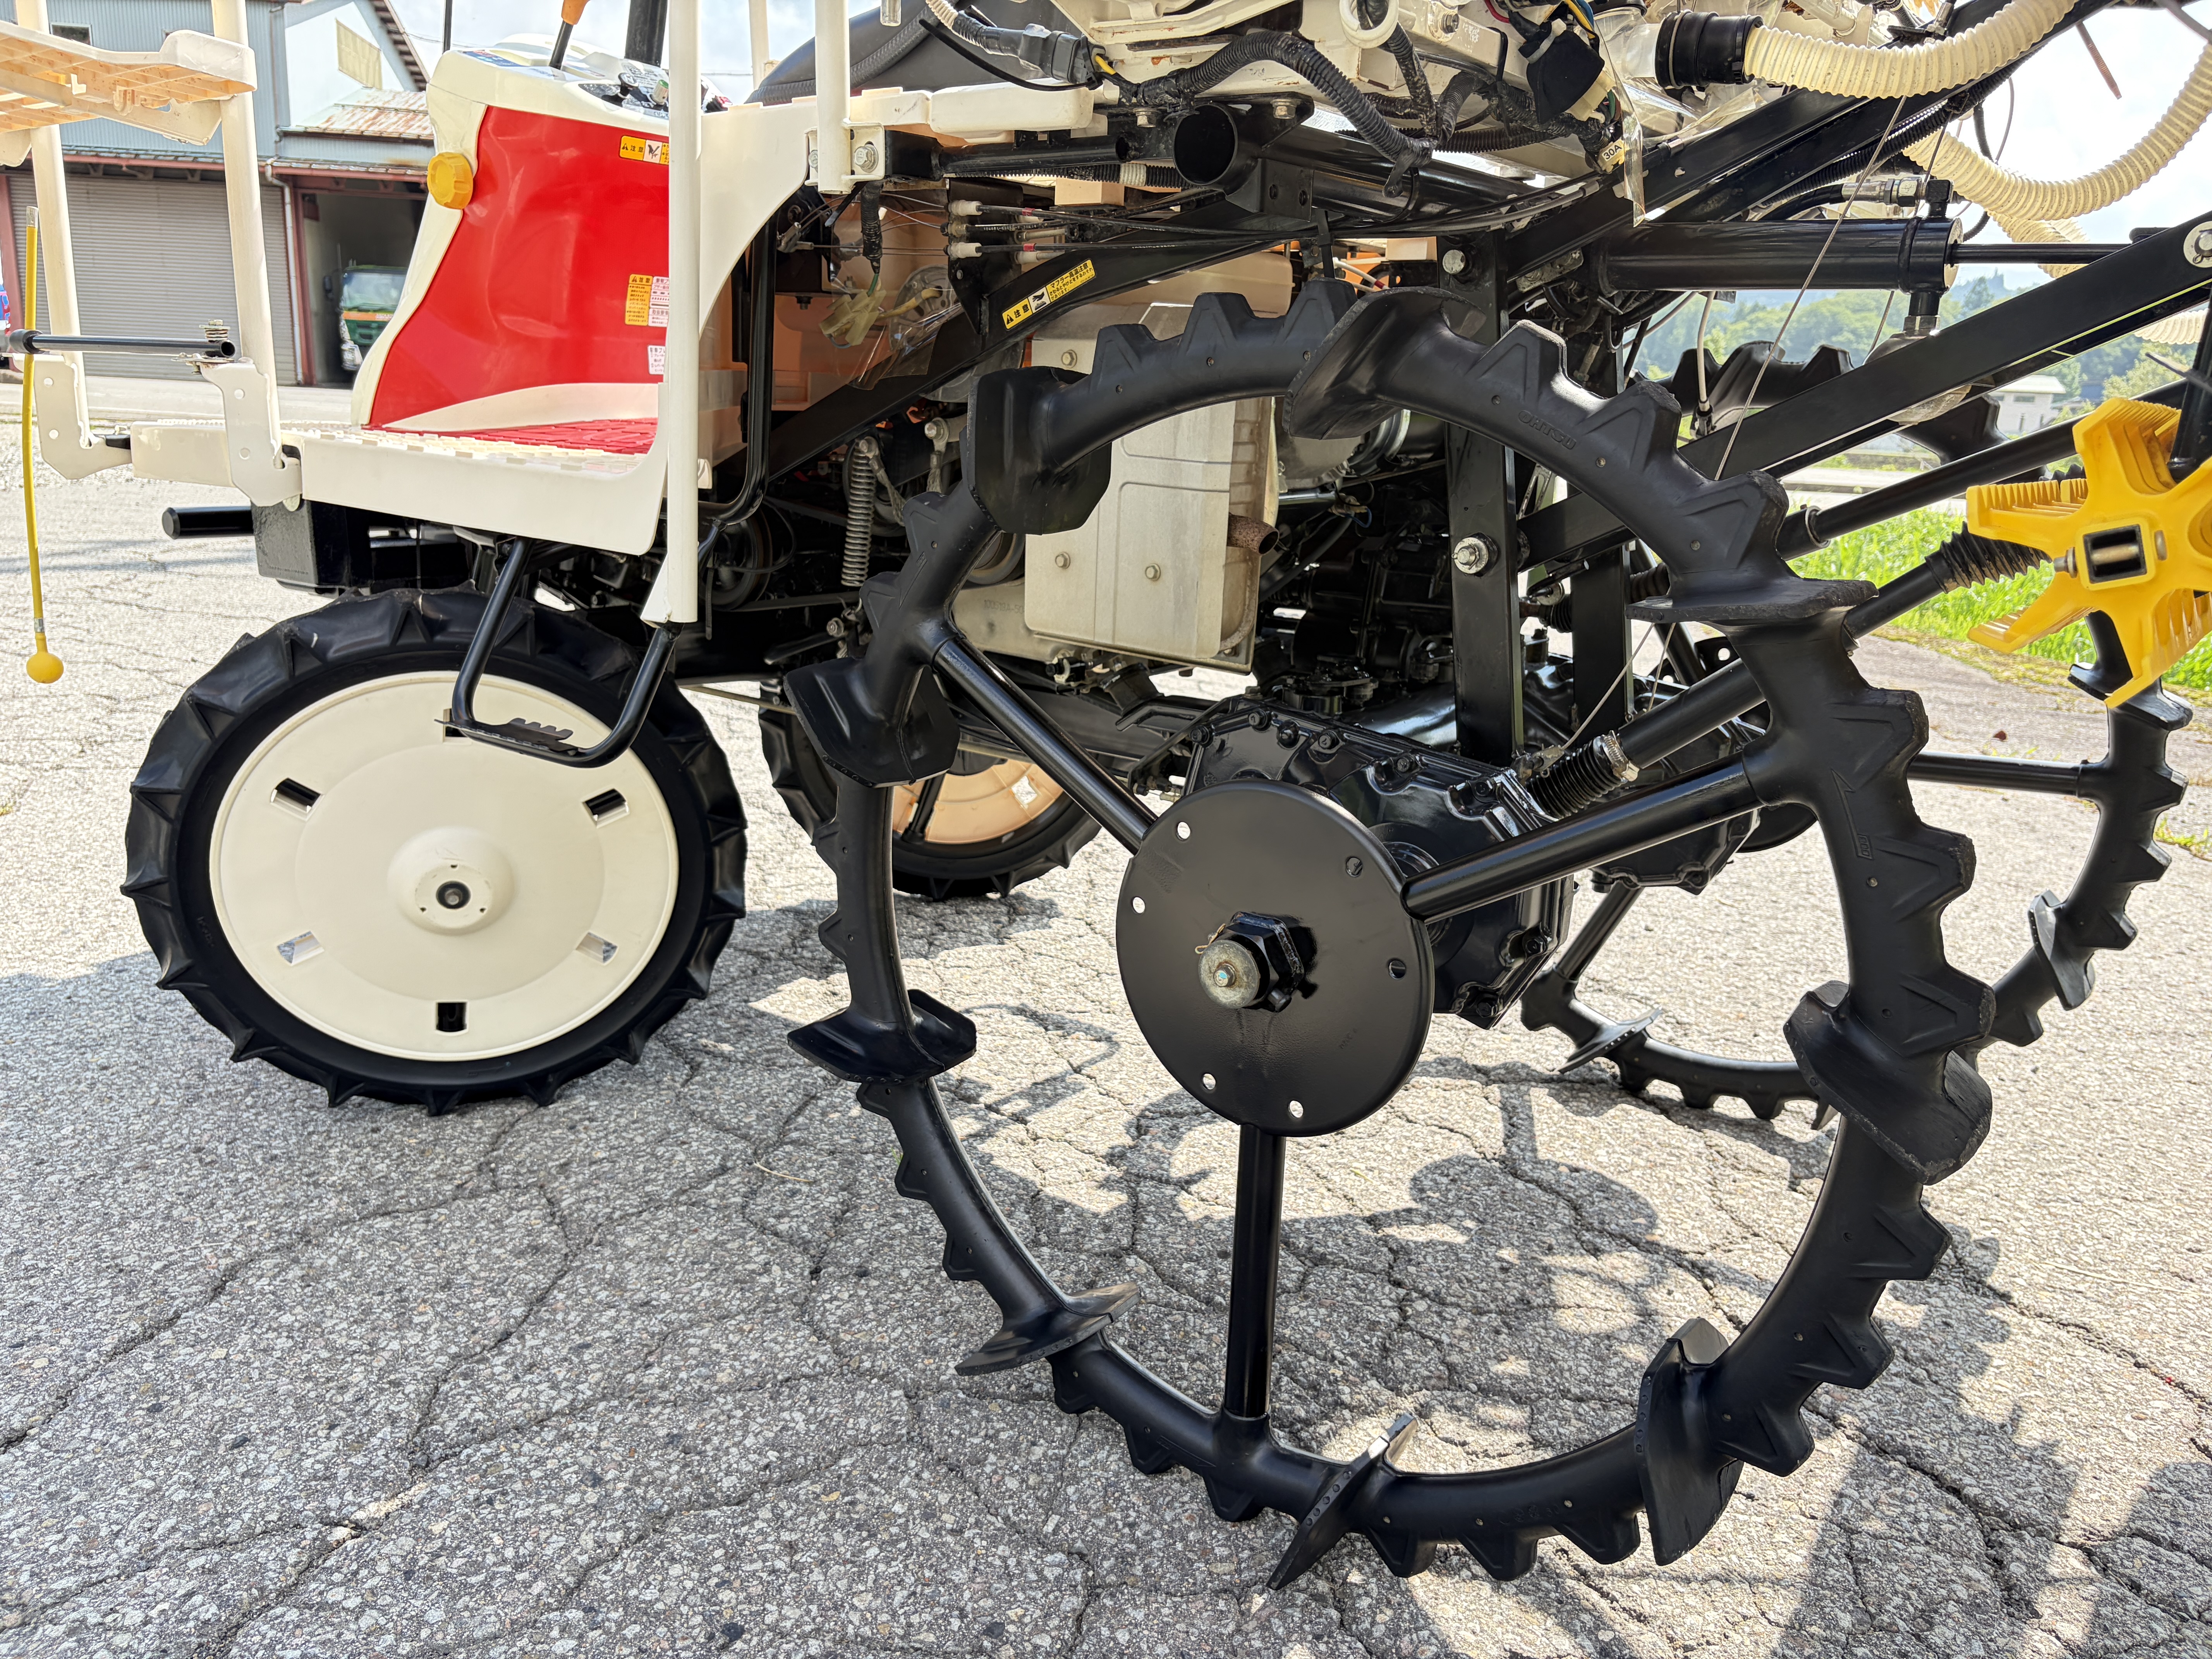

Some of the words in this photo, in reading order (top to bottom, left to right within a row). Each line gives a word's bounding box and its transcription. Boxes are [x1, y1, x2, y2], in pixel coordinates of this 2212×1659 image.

[1604, 145, 1622, 160] 30A
[1050, 263, 1089, 288] マフラー高温注意
[1014, 304, 1029, 318] 注意
[1518, 410, 1577, 450] OHTSU
